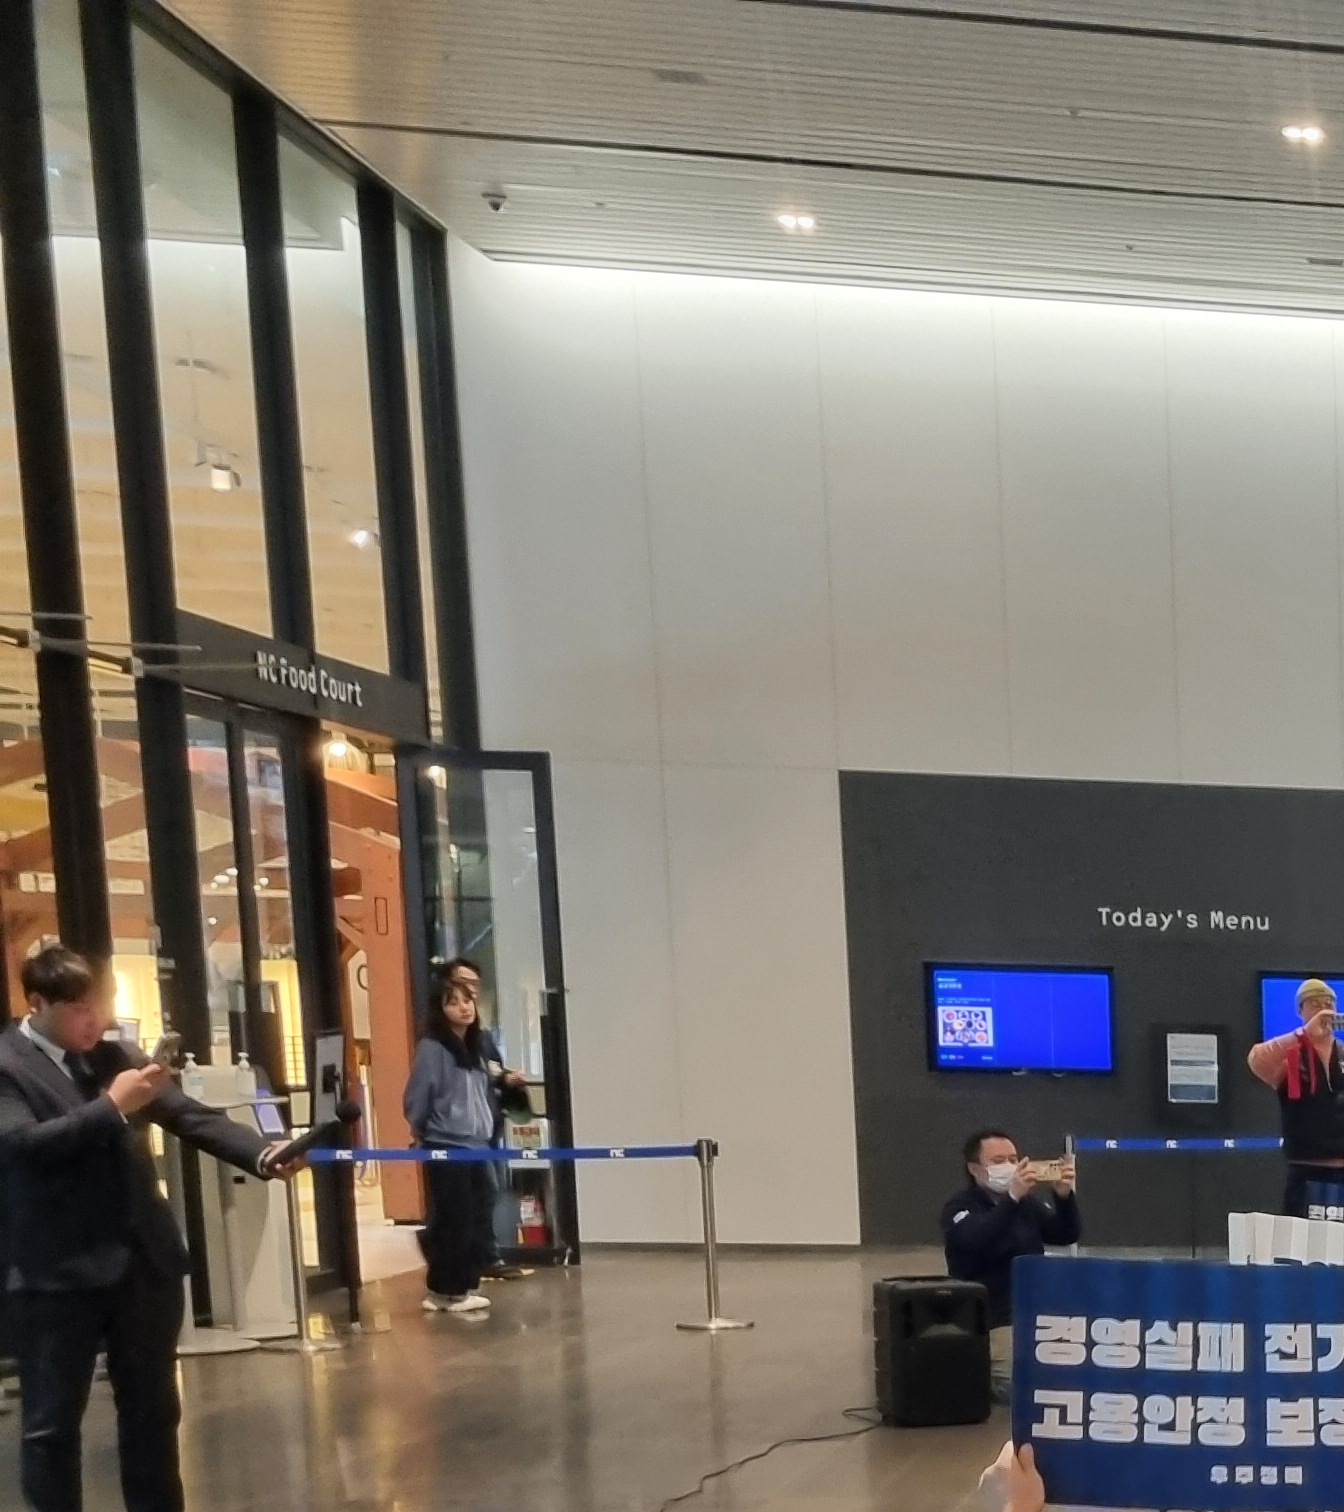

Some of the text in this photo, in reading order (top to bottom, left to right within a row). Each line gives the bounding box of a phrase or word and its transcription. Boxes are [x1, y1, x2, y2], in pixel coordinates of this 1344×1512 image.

[279, 656, 317, 695] Food
[320, 667, 363, 707] Court
[1097, 906, 1270, 932] Today's Menu
[1034, 1315, 1244, 1372] 경영실패
[1031, 1389, 1246, 1443] 고용안정
